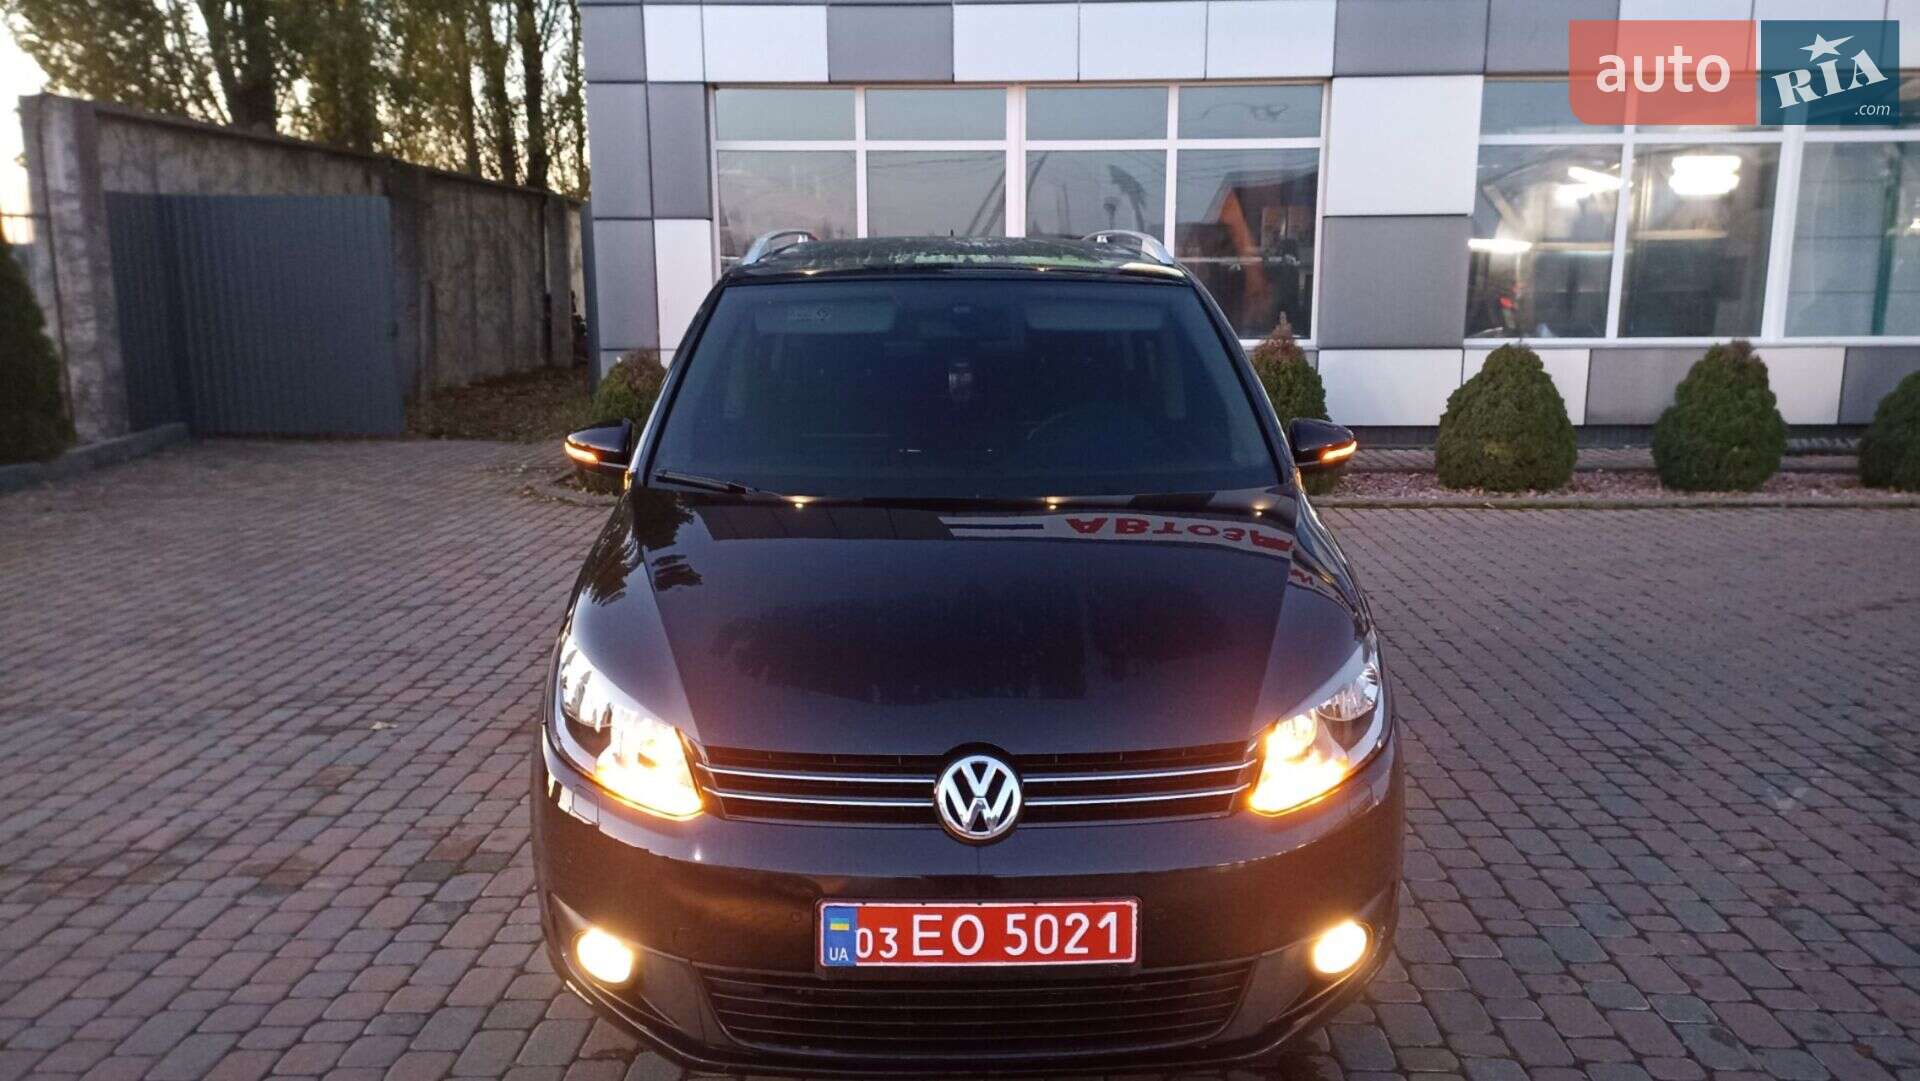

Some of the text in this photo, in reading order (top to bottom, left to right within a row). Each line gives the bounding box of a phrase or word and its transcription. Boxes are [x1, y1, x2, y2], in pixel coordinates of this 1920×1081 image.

[937, 755, 1021, 840] VW
[829, 948, 850, 962] UA
[856, 911, 1118, 959] 03 EO 5021
